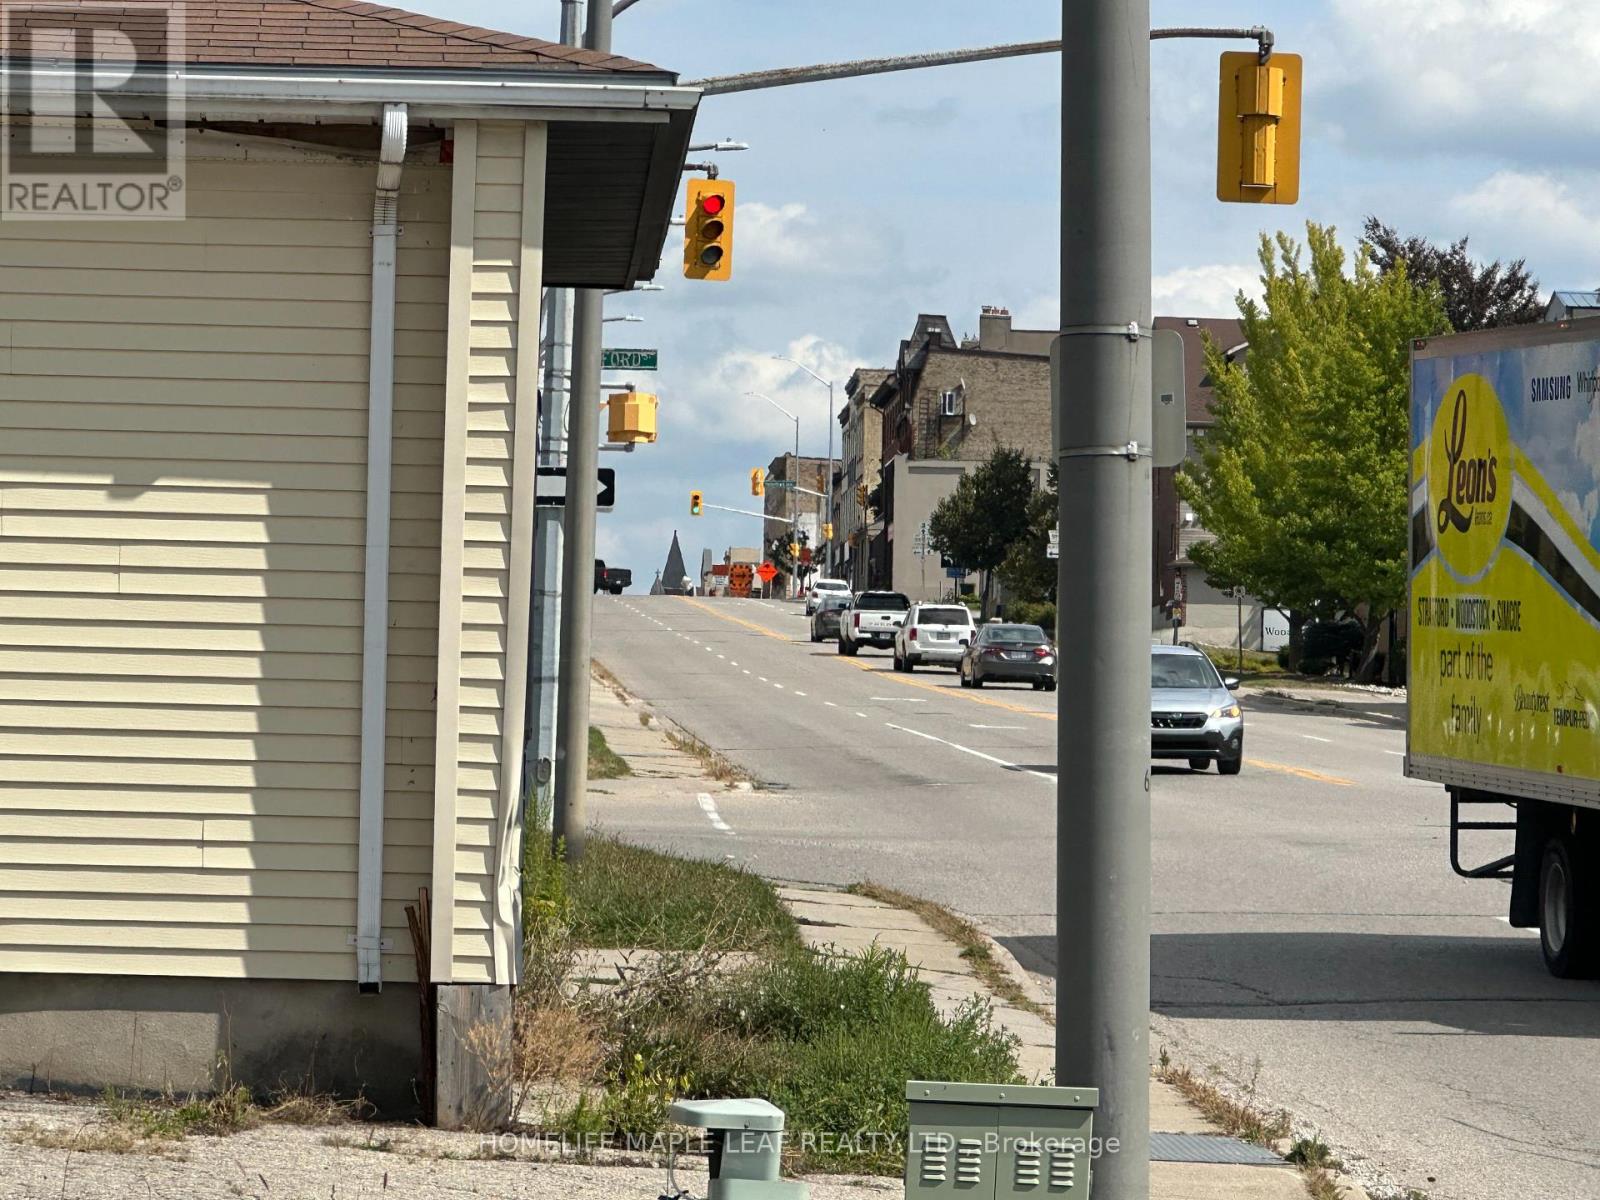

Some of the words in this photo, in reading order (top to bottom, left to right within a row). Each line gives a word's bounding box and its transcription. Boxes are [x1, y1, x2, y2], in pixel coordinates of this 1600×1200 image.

[1531, 375, 1571, 403] SAMSUNG
[1437, 389, 1498, 534] Leon's
[1455, 598, 1491, 631] WOODSTOCK
[1497, 599, 1522, 632] SIMCOE
[1440, 641, 1462, 687] part
[1465, 640, 1475, 680] of
[1477, 640, 1493, 682] the
[1450, 692, 1482, 745] family
